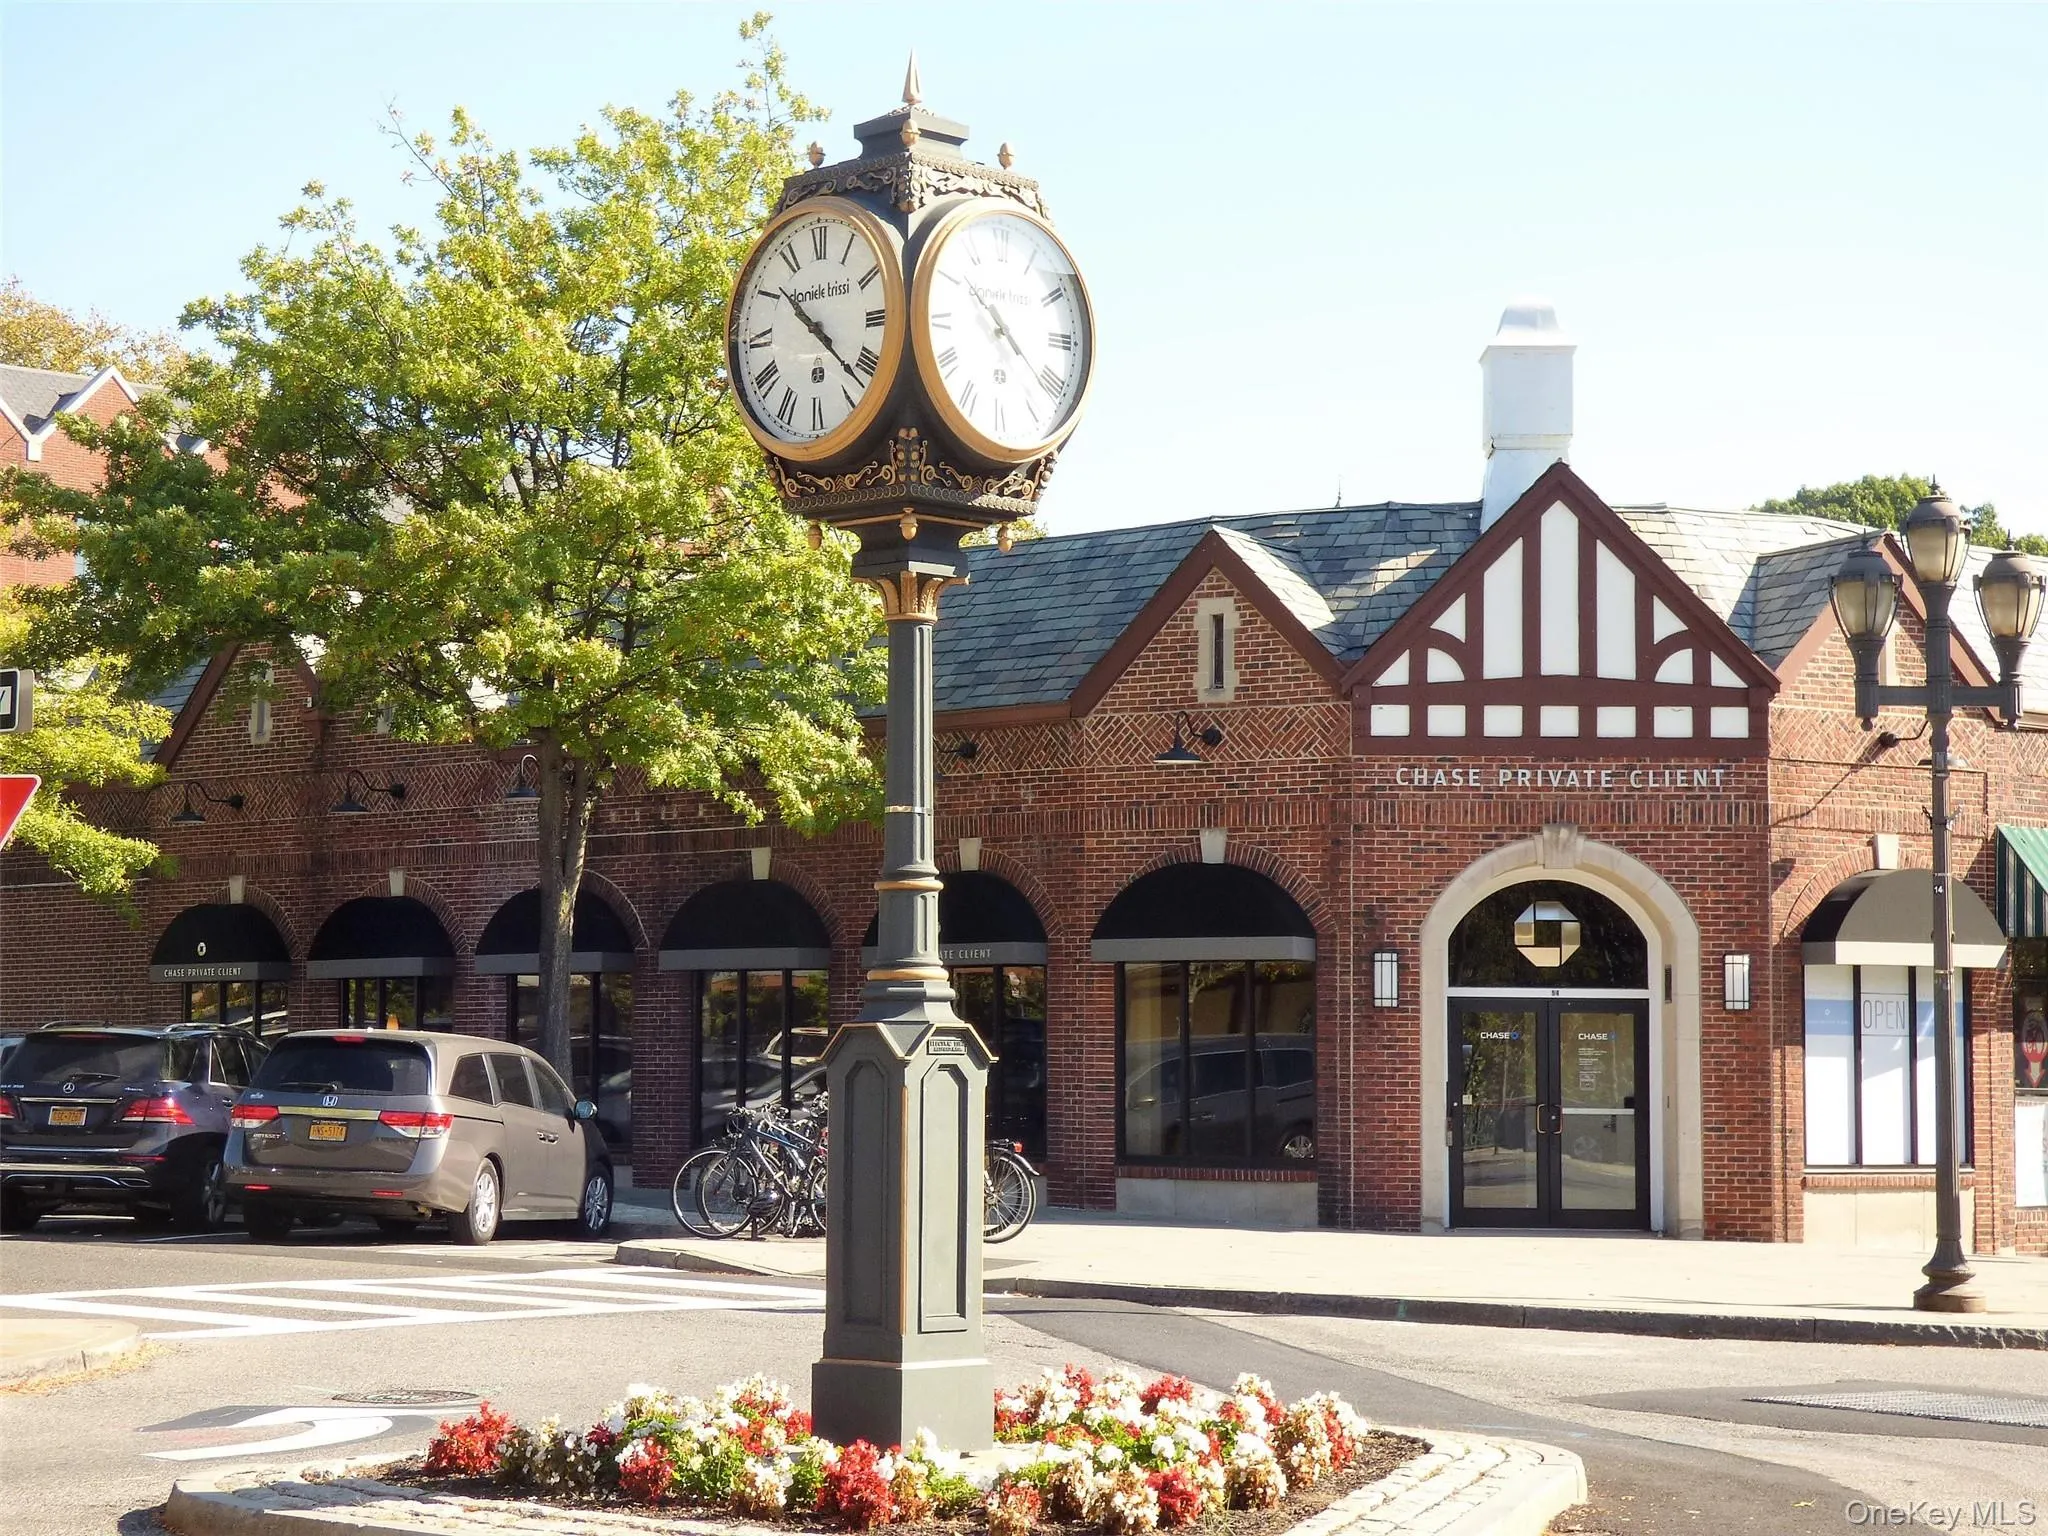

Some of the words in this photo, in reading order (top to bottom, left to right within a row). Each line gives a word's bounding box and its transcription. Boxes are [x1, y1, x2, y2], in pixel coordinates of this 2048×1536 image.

[828, 278, 850, 297] trissi
[1396, 767, 1481, 787] CHASE
[1499, 769, 1614, 788] PRIVATE
[1630, 769, 1725, 788] CLIENT
[959, 949, 991, 959] CLIENT
[164, 968, 185, 977] CHASE
[187, 968, 215, 976] PRIVATE
[218, 967, 241, 976] CLIENT
[1862, 999, 1906, 1030] OPEN
[1480, 1031, 1510, 1040] CHASE
[1578, 1032, 1608, 1041] CHASE
